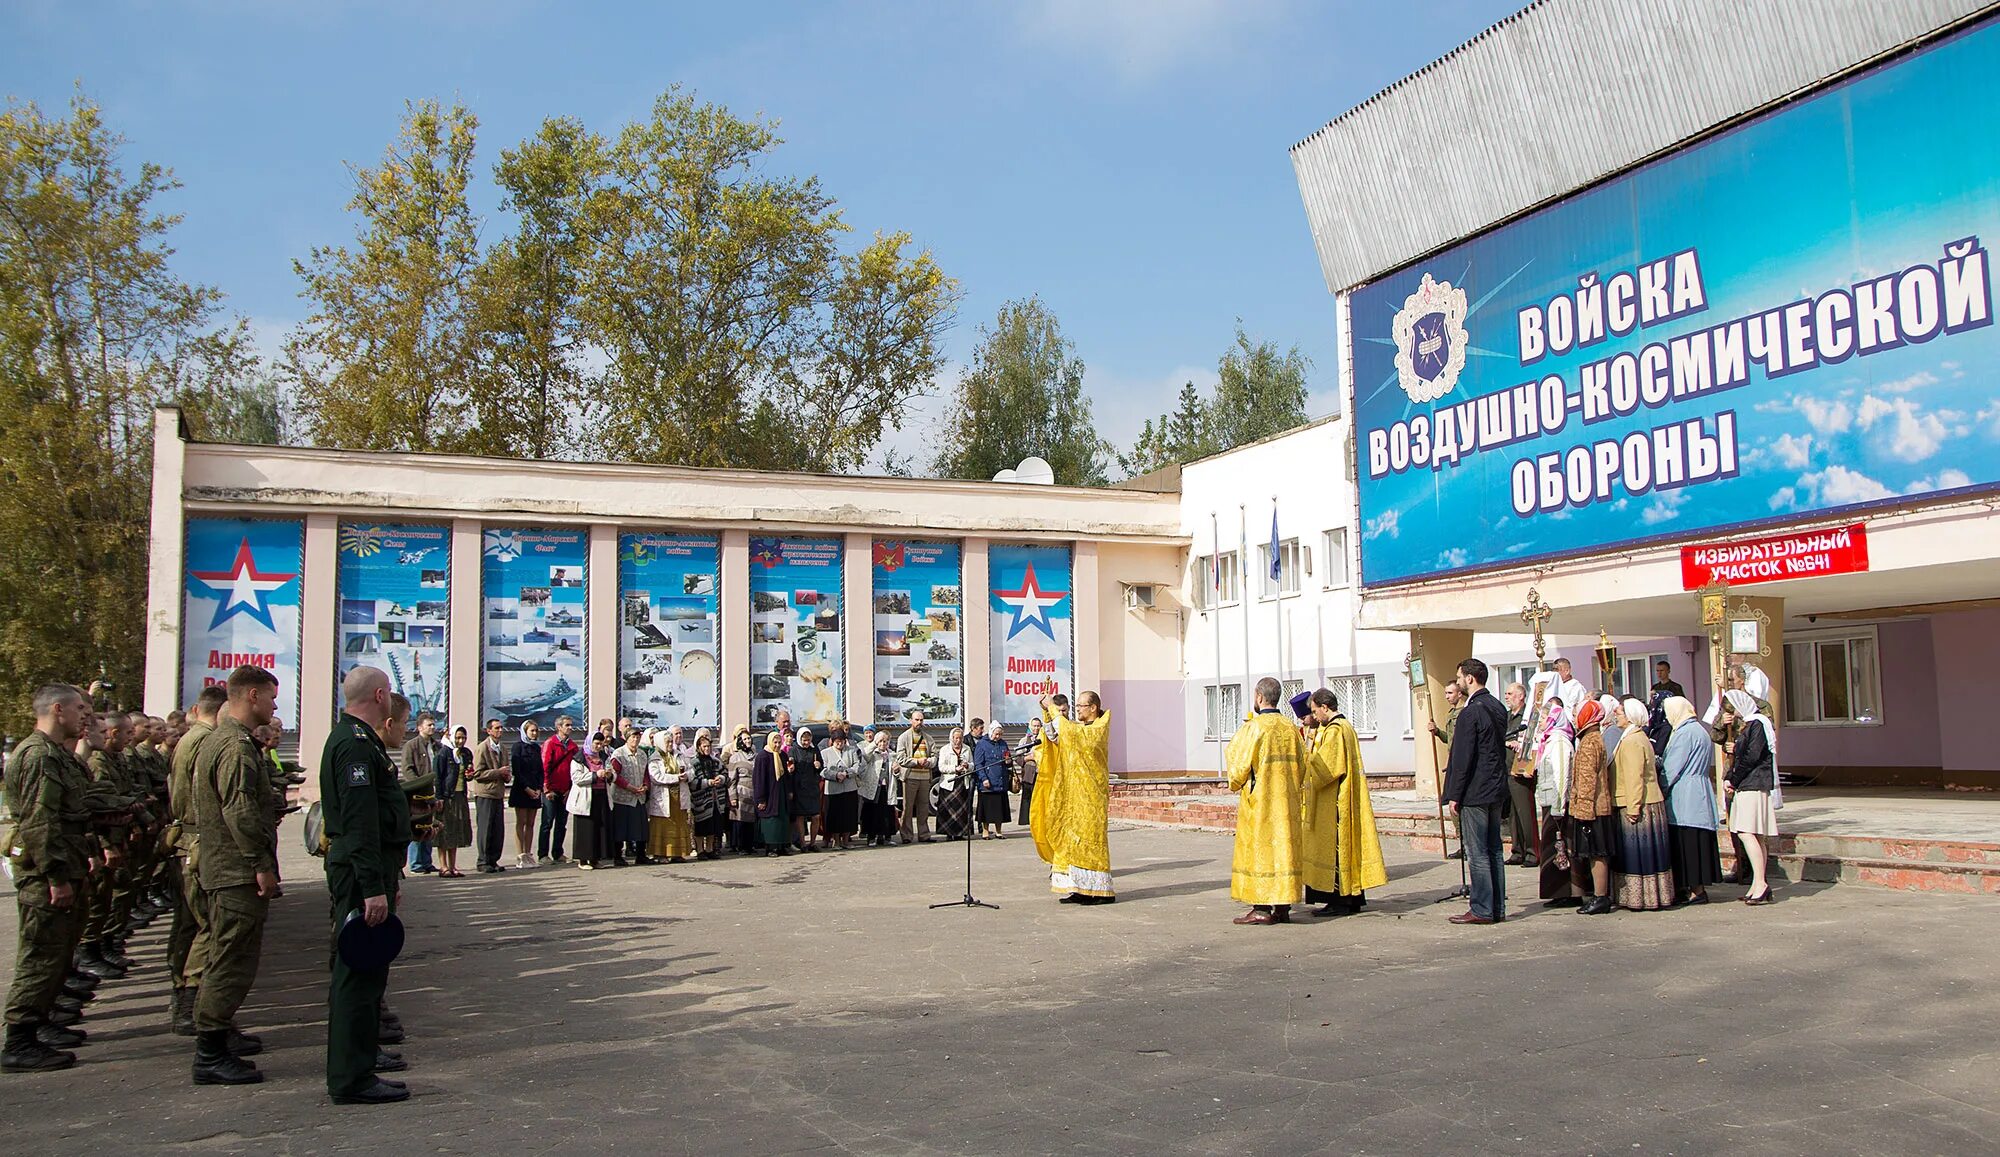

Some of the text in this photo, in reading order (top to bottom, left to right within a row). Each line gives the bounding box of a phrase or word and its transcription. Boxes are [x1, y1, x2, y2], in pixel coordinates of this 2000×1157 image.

[1520, 250, 1704, 364] ВОЙСКА
[1369, 239, 1988, 477] ВОЗДУШНО-КОСМИЧЕСКОЙ
[1512, 412, 1737, 514] ОБОРОНЫ
[1694, 529, 1851, 566] ИЗБИРАТЕЛЬНЫЙ
[1711, 553, 1830, 580] УЧАСТОК №641
[208, 650, 275, 670] Армия
[1007, 656, 1055, 673] Армия
